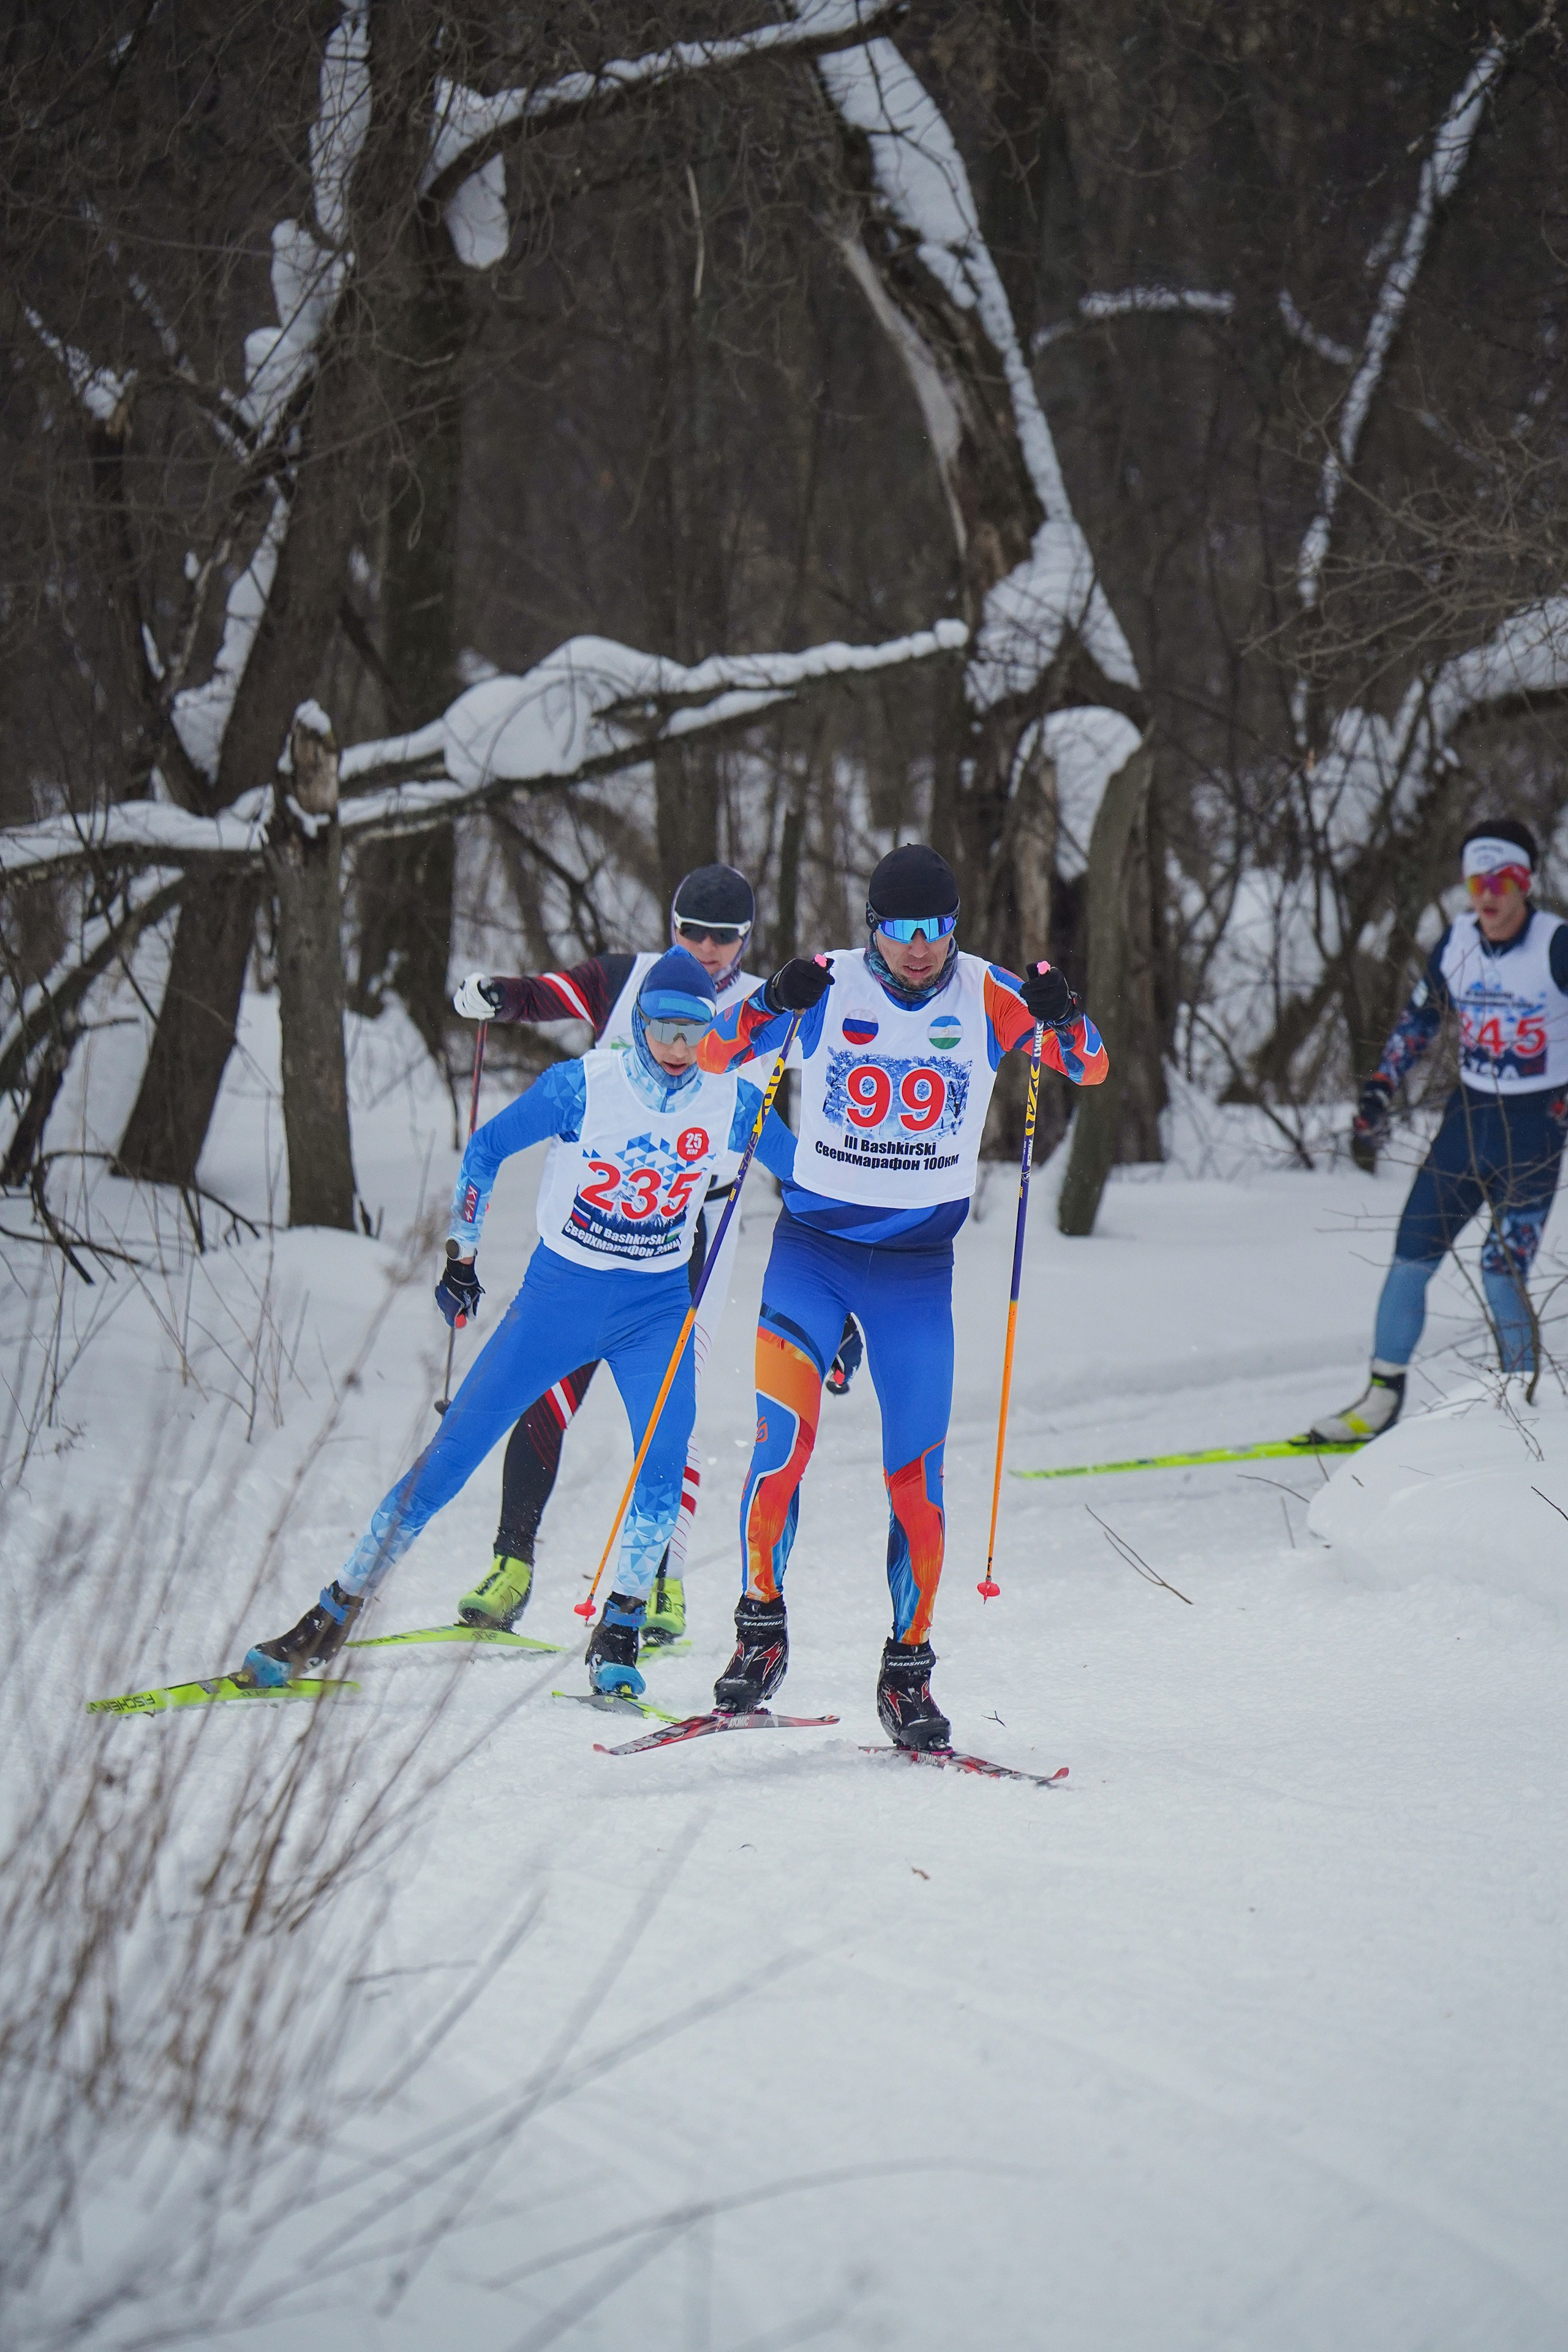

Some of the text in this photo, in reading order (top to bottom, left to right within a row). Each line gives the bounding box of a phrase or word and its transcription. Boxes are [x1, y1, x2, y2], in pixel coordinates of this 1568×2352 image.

[846, 1066, 946, 1131] 99
[685, 1133, 703, 1149] 25
[844, 1134, 937, 1156] III BashkirSki
[815, 1140, 960, 1170] Сверхмарафон 100км
[580, 1161, 703, 1219] 235
[564, 1219, 655, 1257] Сверхмарафон
[590, 1221, 667, 1245] IV BashkirSki
[103, 1694, 156, 1714] FISCHER
[727, 1715, 750, 1729] ATOMIC
